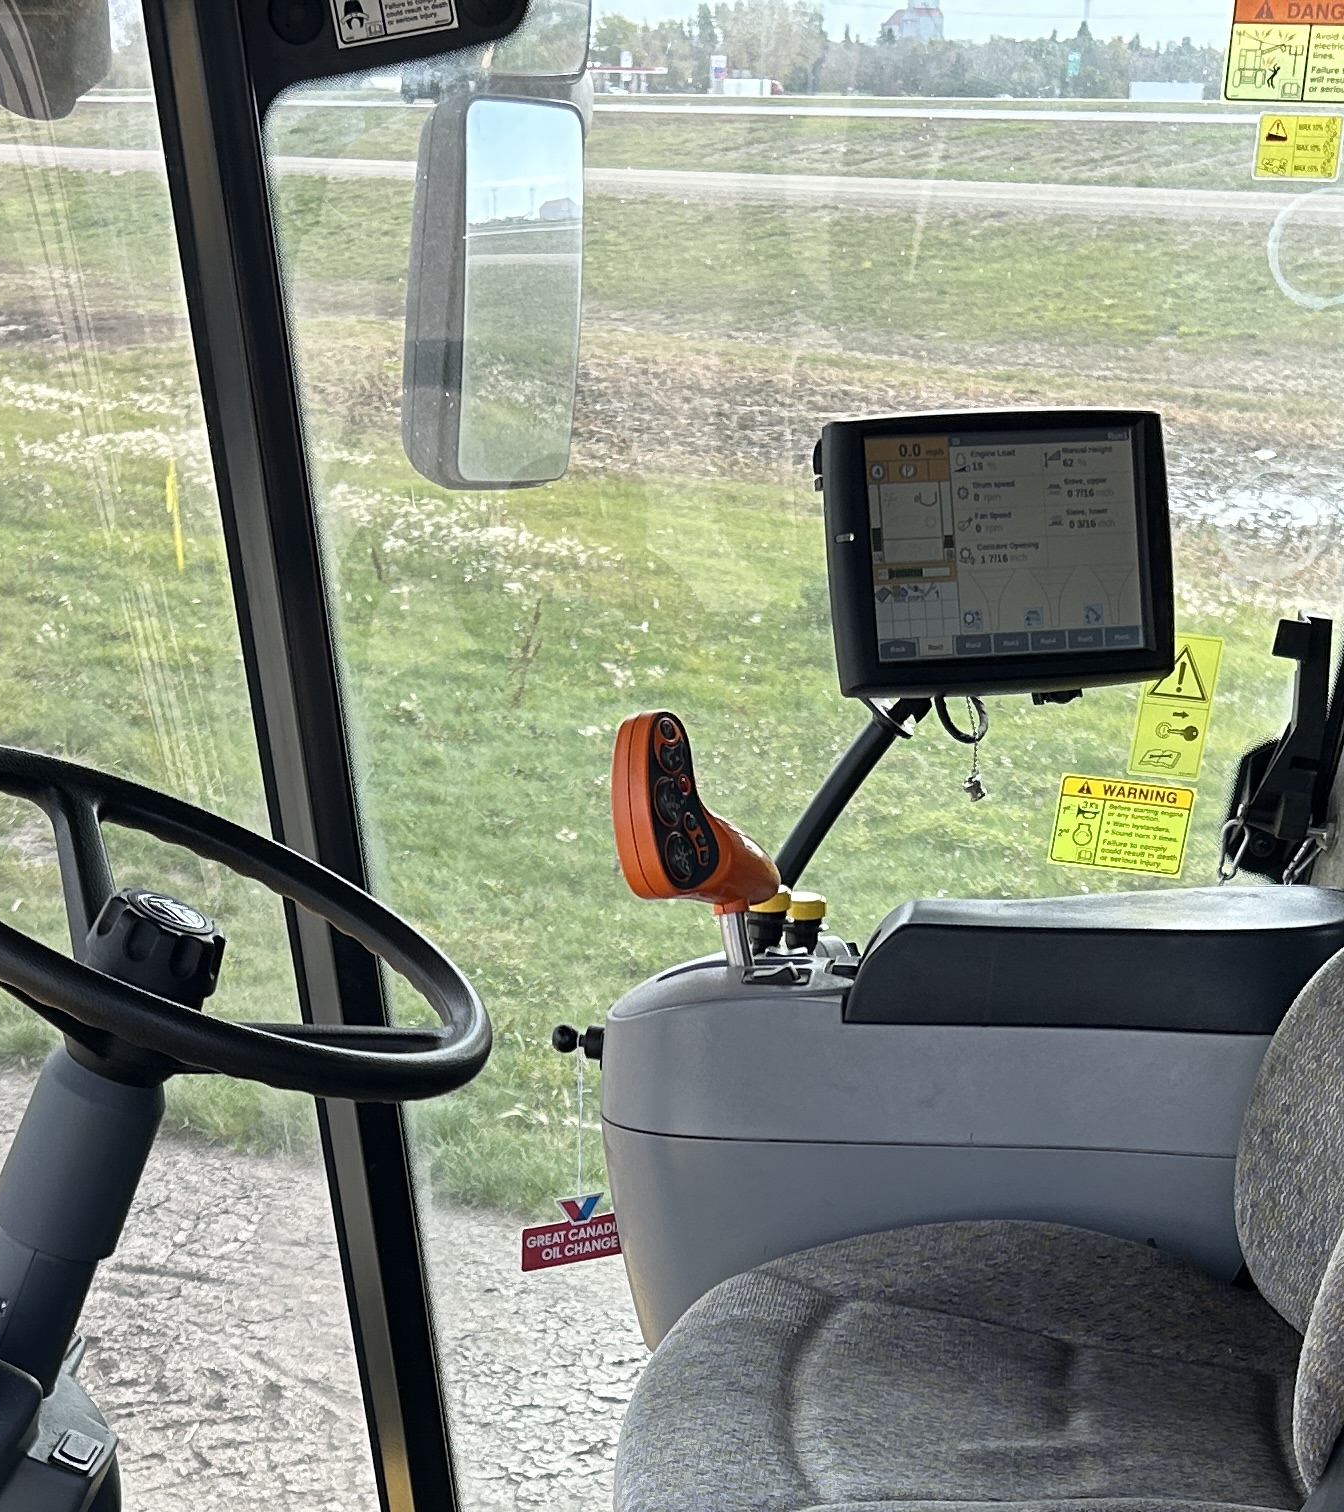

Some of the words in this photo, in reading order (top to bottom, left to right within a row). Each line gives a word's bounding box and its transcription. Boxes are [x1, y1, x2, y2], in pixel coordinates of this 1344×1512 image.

[386, 10, 403, 18] could
[405, 6, 422, 14] result
[1311, 66, 1339, 74] Failure
[899, 444, 921, 457] 0.0
[970, 450, 996, 459] Engine
[1103, 784, 1177, 804] WARNING
[1134, 808, 1159, 816] starting
[1161, 810, 1183, 818] engine
[1111, 829, 1133, 837] Sound
[1103, 839, 1128, 847] Failure
[1140, 844, 1167, 853] comply
[1157, 853, 1177, 861] death
[526, 1230, 566, 1249] GREAT
[568, 1222, 618, 1241] CANADI
[541, 1249, 563, 1261] OIL
[564, 1236, 618, 1256] CHANGE
